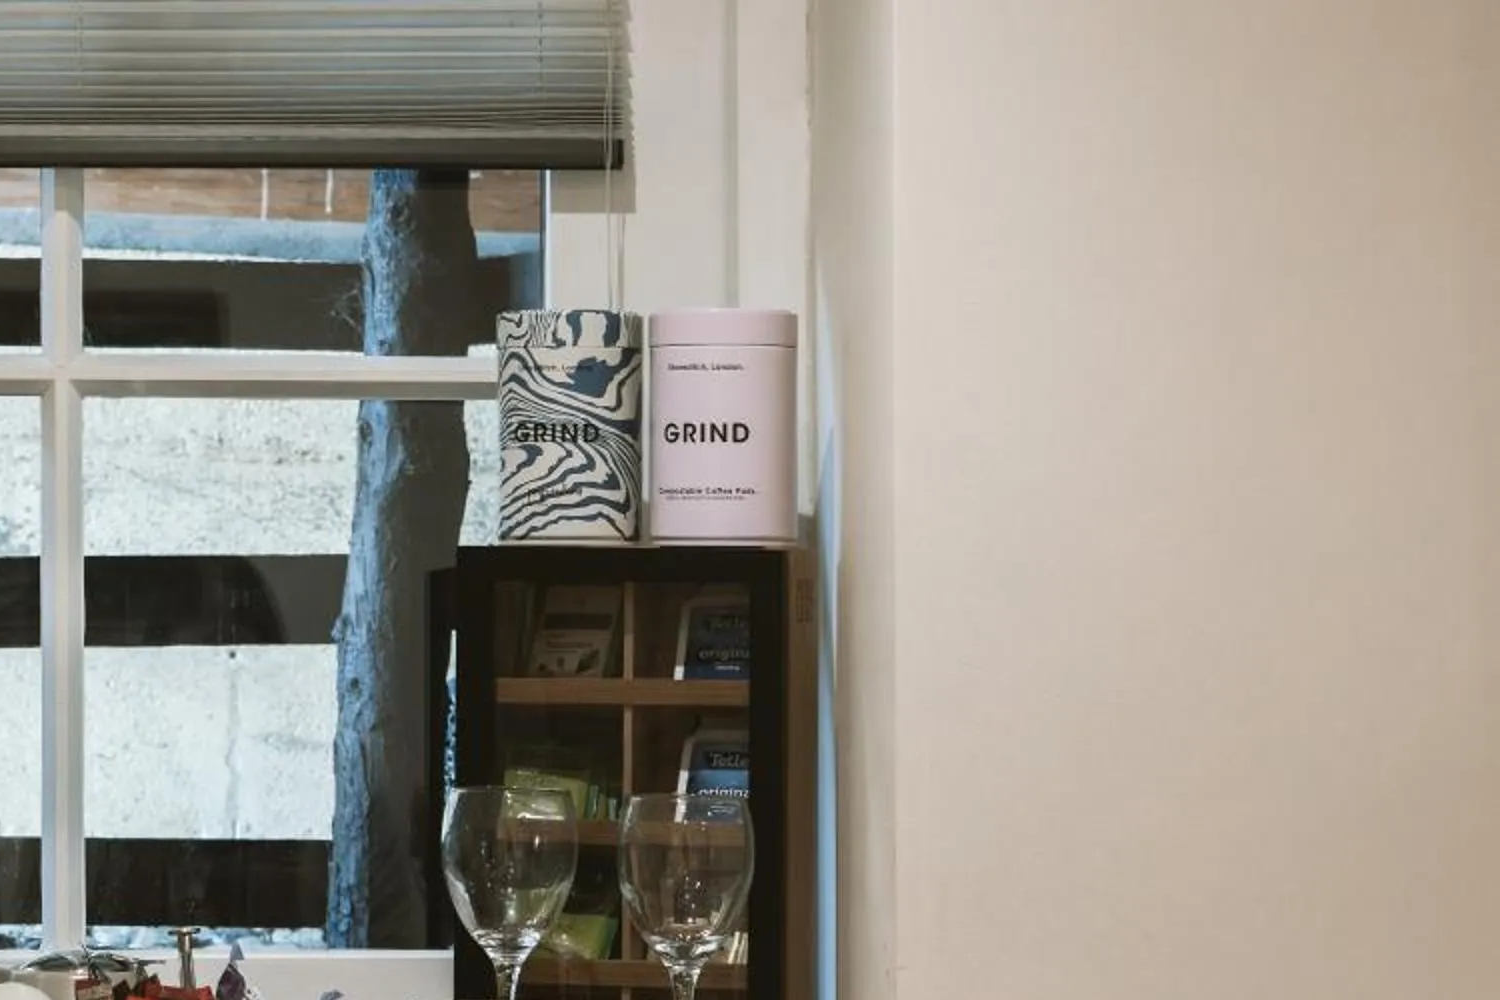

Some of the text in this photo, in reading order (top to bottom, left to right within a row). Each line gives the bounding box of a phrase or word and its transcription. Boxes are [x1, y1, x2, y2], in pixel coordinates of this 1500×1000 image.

[516, 423, 600, 443] GRIND
[664, 422, 750, 443] GRIND
[709, 752, 749, 767] Tetle
